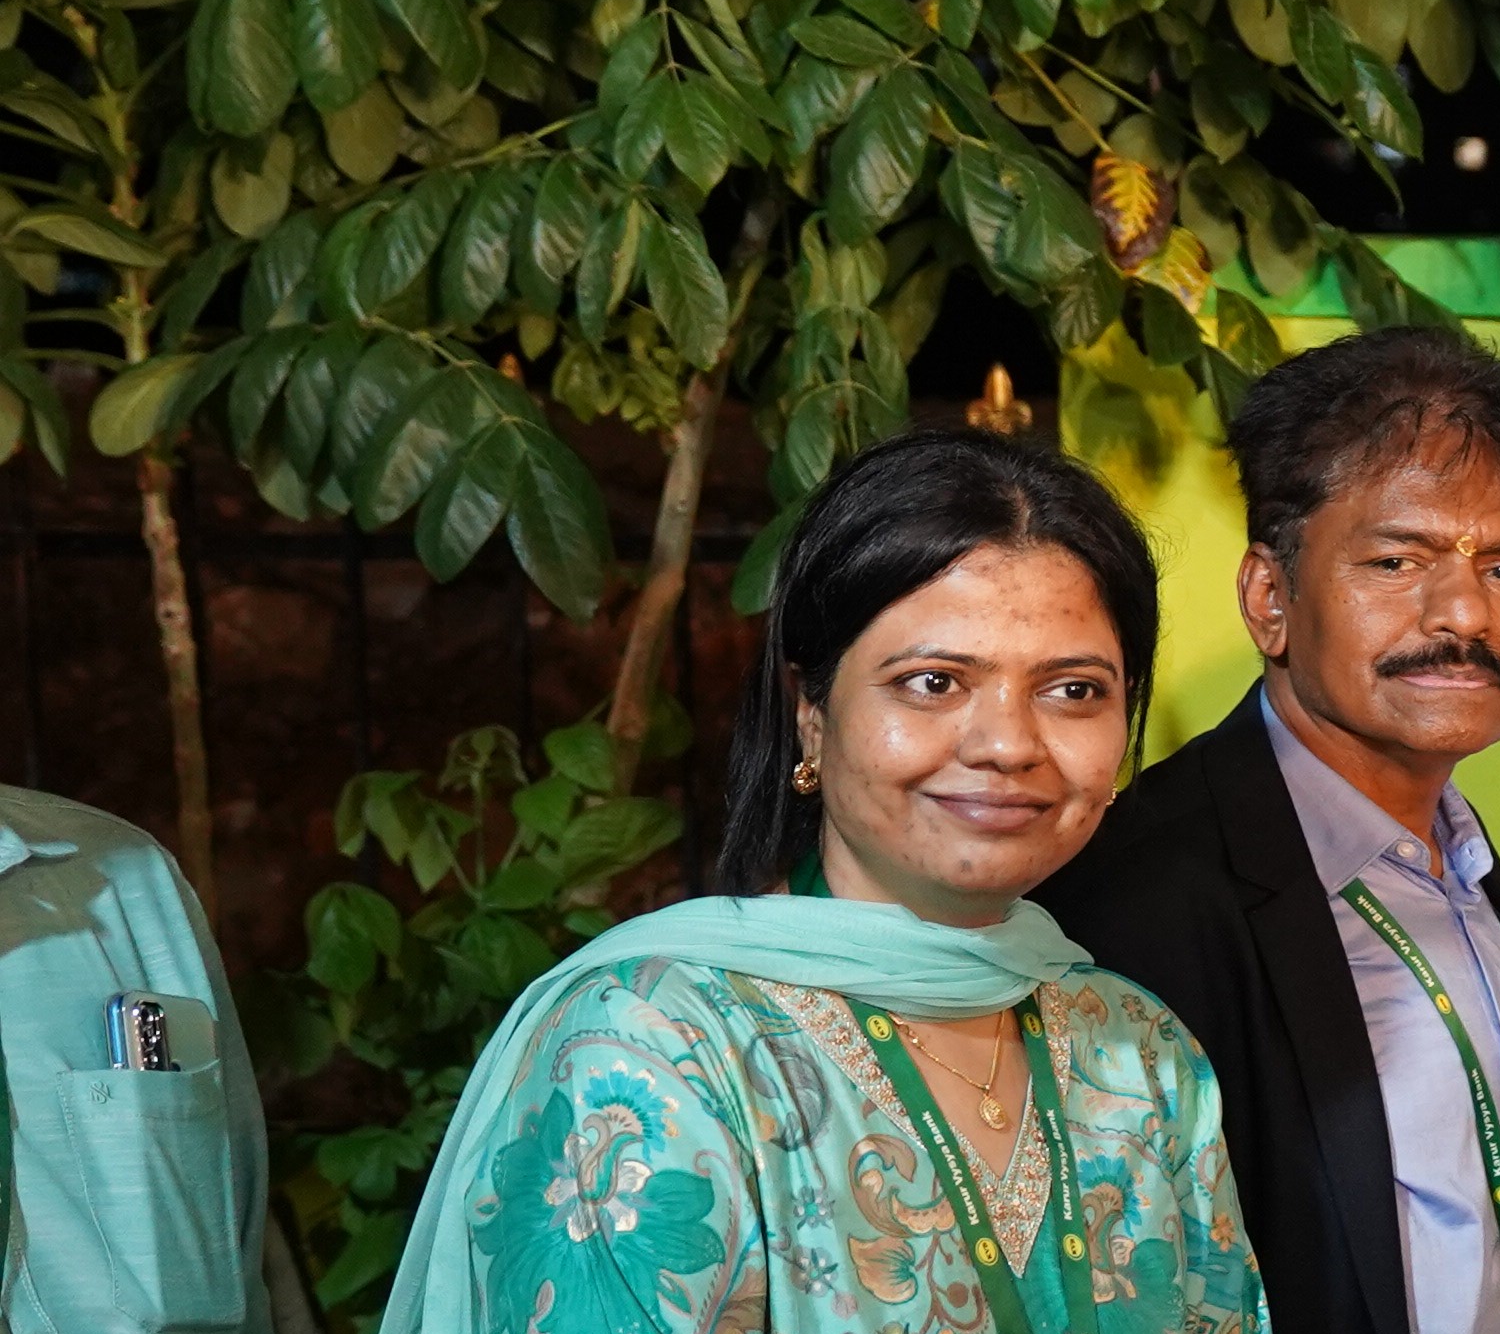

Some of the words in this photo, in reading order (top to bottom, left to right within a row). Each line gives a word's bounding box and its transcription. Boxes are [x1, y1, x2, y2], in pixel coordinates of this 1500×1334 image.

[1357, 895, 1384, 923] Bank
[1383, 922, 1411, 955] Vysya
[1410, 955, 1435, 988] Karur
[1471, 1067, 1485, 1101] Bank
[921, 1110, 944, 1146] Bank
[1046, 1108, 1061, 1141] Bank
[1480, 1102, 1495, 1141] Vysya
[939, 1141, 965, 1188] Vysya
[1056, 1141, 1070, 1183] Vysya
[958, 1183, 981, 1226] Karur
[1063, 1181, 1074, 1221] Karur
